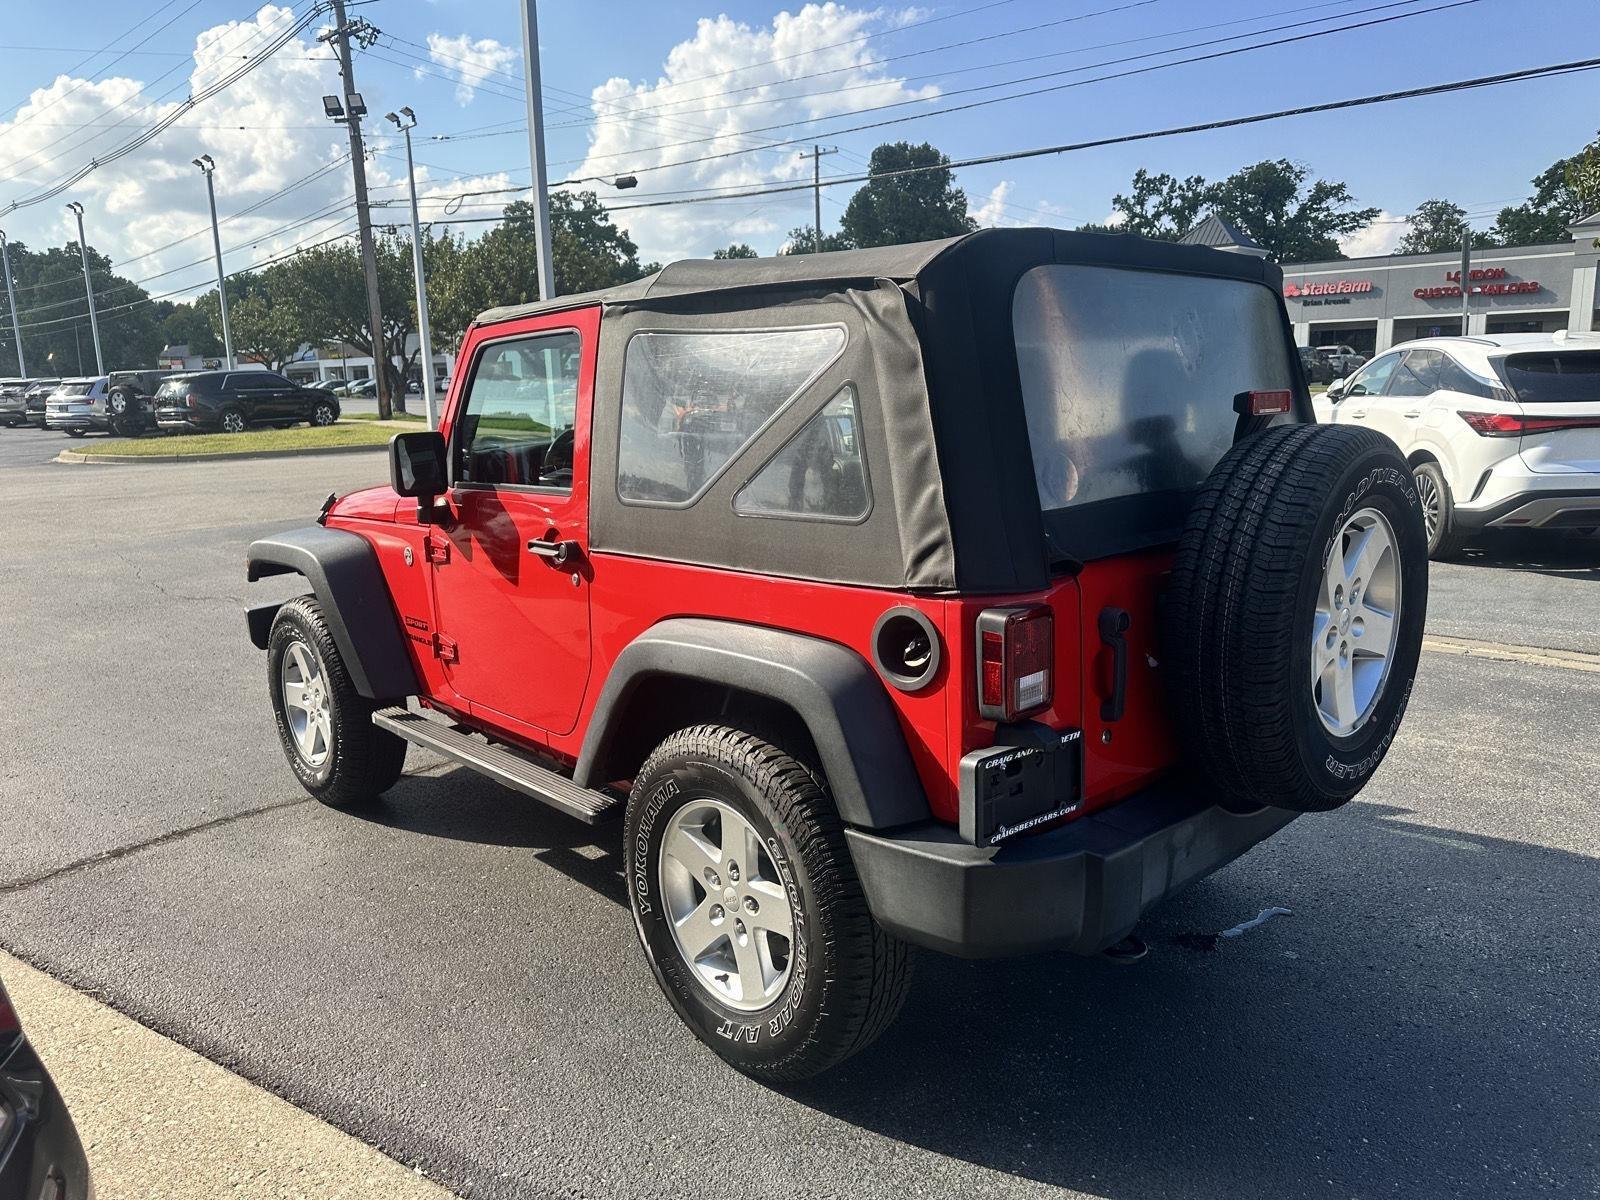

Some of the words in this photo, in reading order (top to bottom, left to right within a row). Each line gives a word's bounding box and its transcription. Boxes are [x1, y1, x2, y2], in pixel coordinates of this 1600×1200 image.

[1480, 281, 1539, 296] TAILORS
[1322, 467, 1417, 570] GOODYEAR
[406, 617, 428, 630] SPORT
[985, 754, 1013, 769] CRAIG
[1014, 748, 1034, 760] AND
[990, 804, 1077, 844] CRAIGSBESTCARS.COM
[634, 779, 681, 915] YOKOHAMA
[768, 837, 808, 1037] GEOLANDAR
[716, 1022, 762, 1043] A/T
